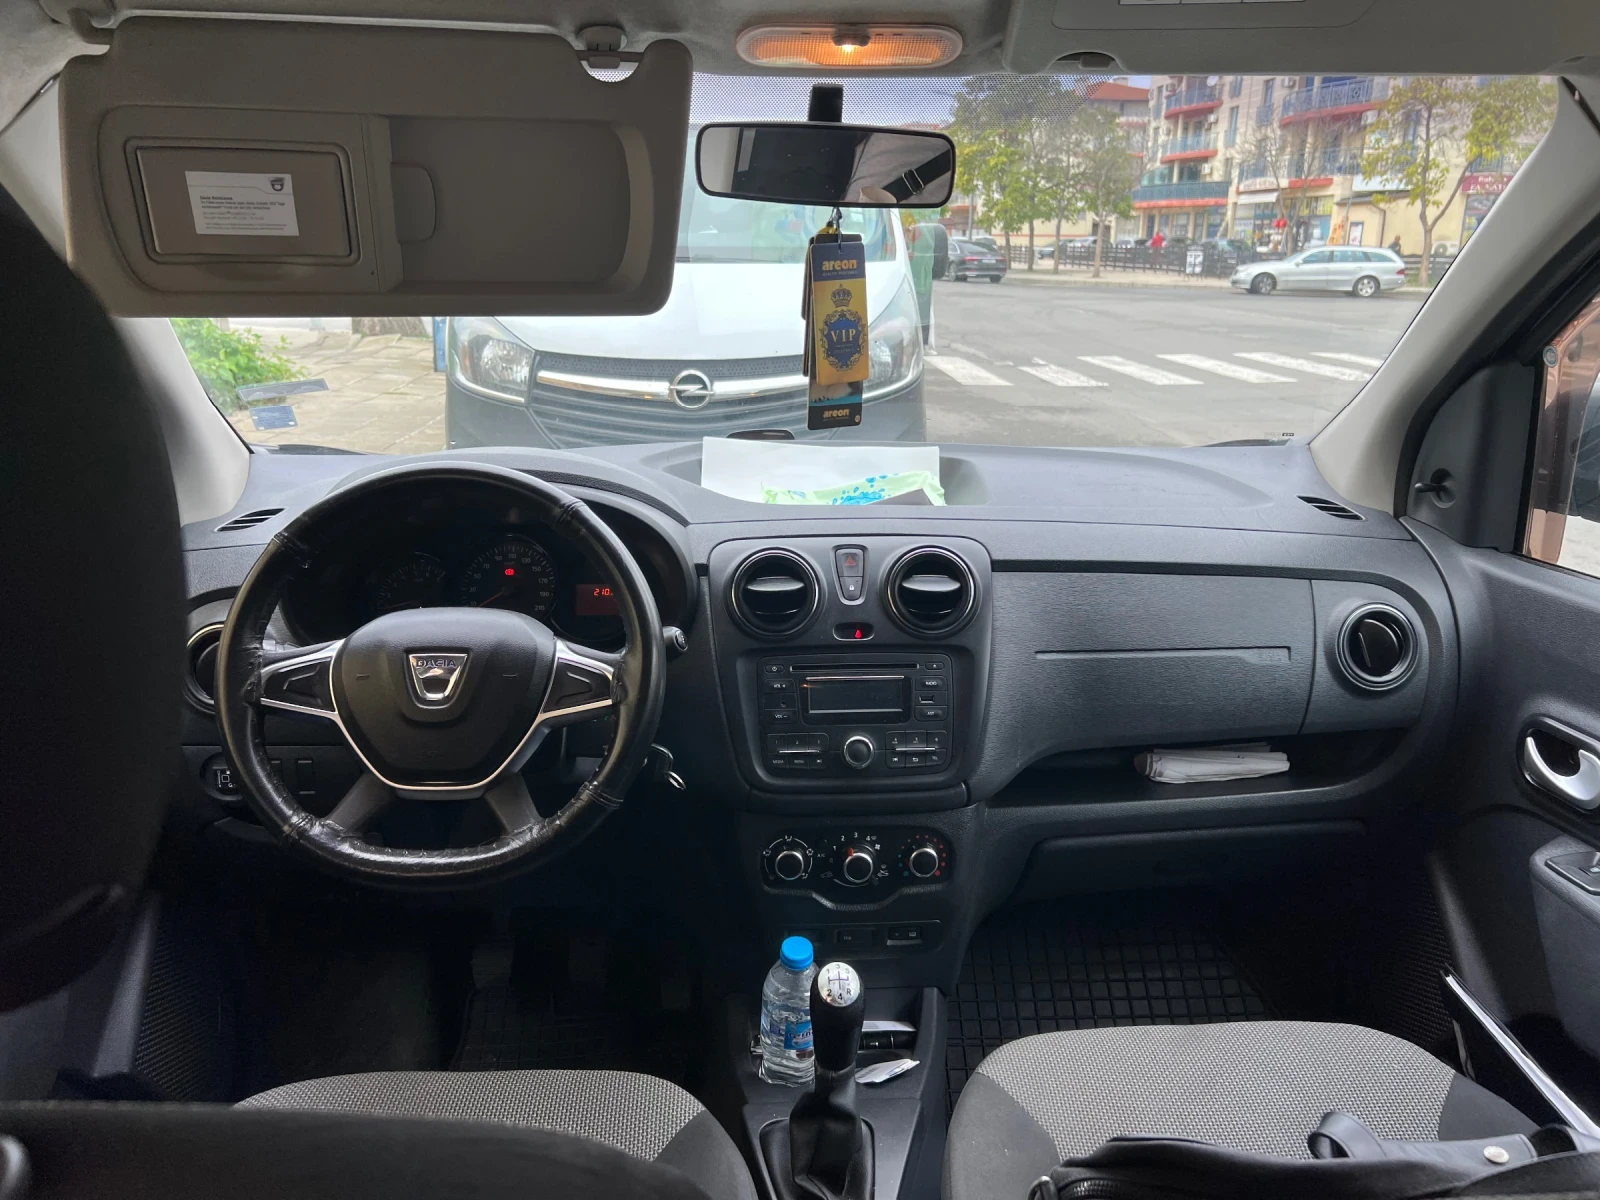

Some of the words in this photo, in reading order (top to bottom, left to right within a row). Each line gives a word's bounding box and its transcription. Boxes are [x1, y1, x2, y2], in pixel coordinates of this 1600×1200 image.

[822, 259, 857, 271] areon
[830, 328, 856, 342] VIP
[823, 408, 850, 418] areon
[416, 658, 457, 668] DACIA
